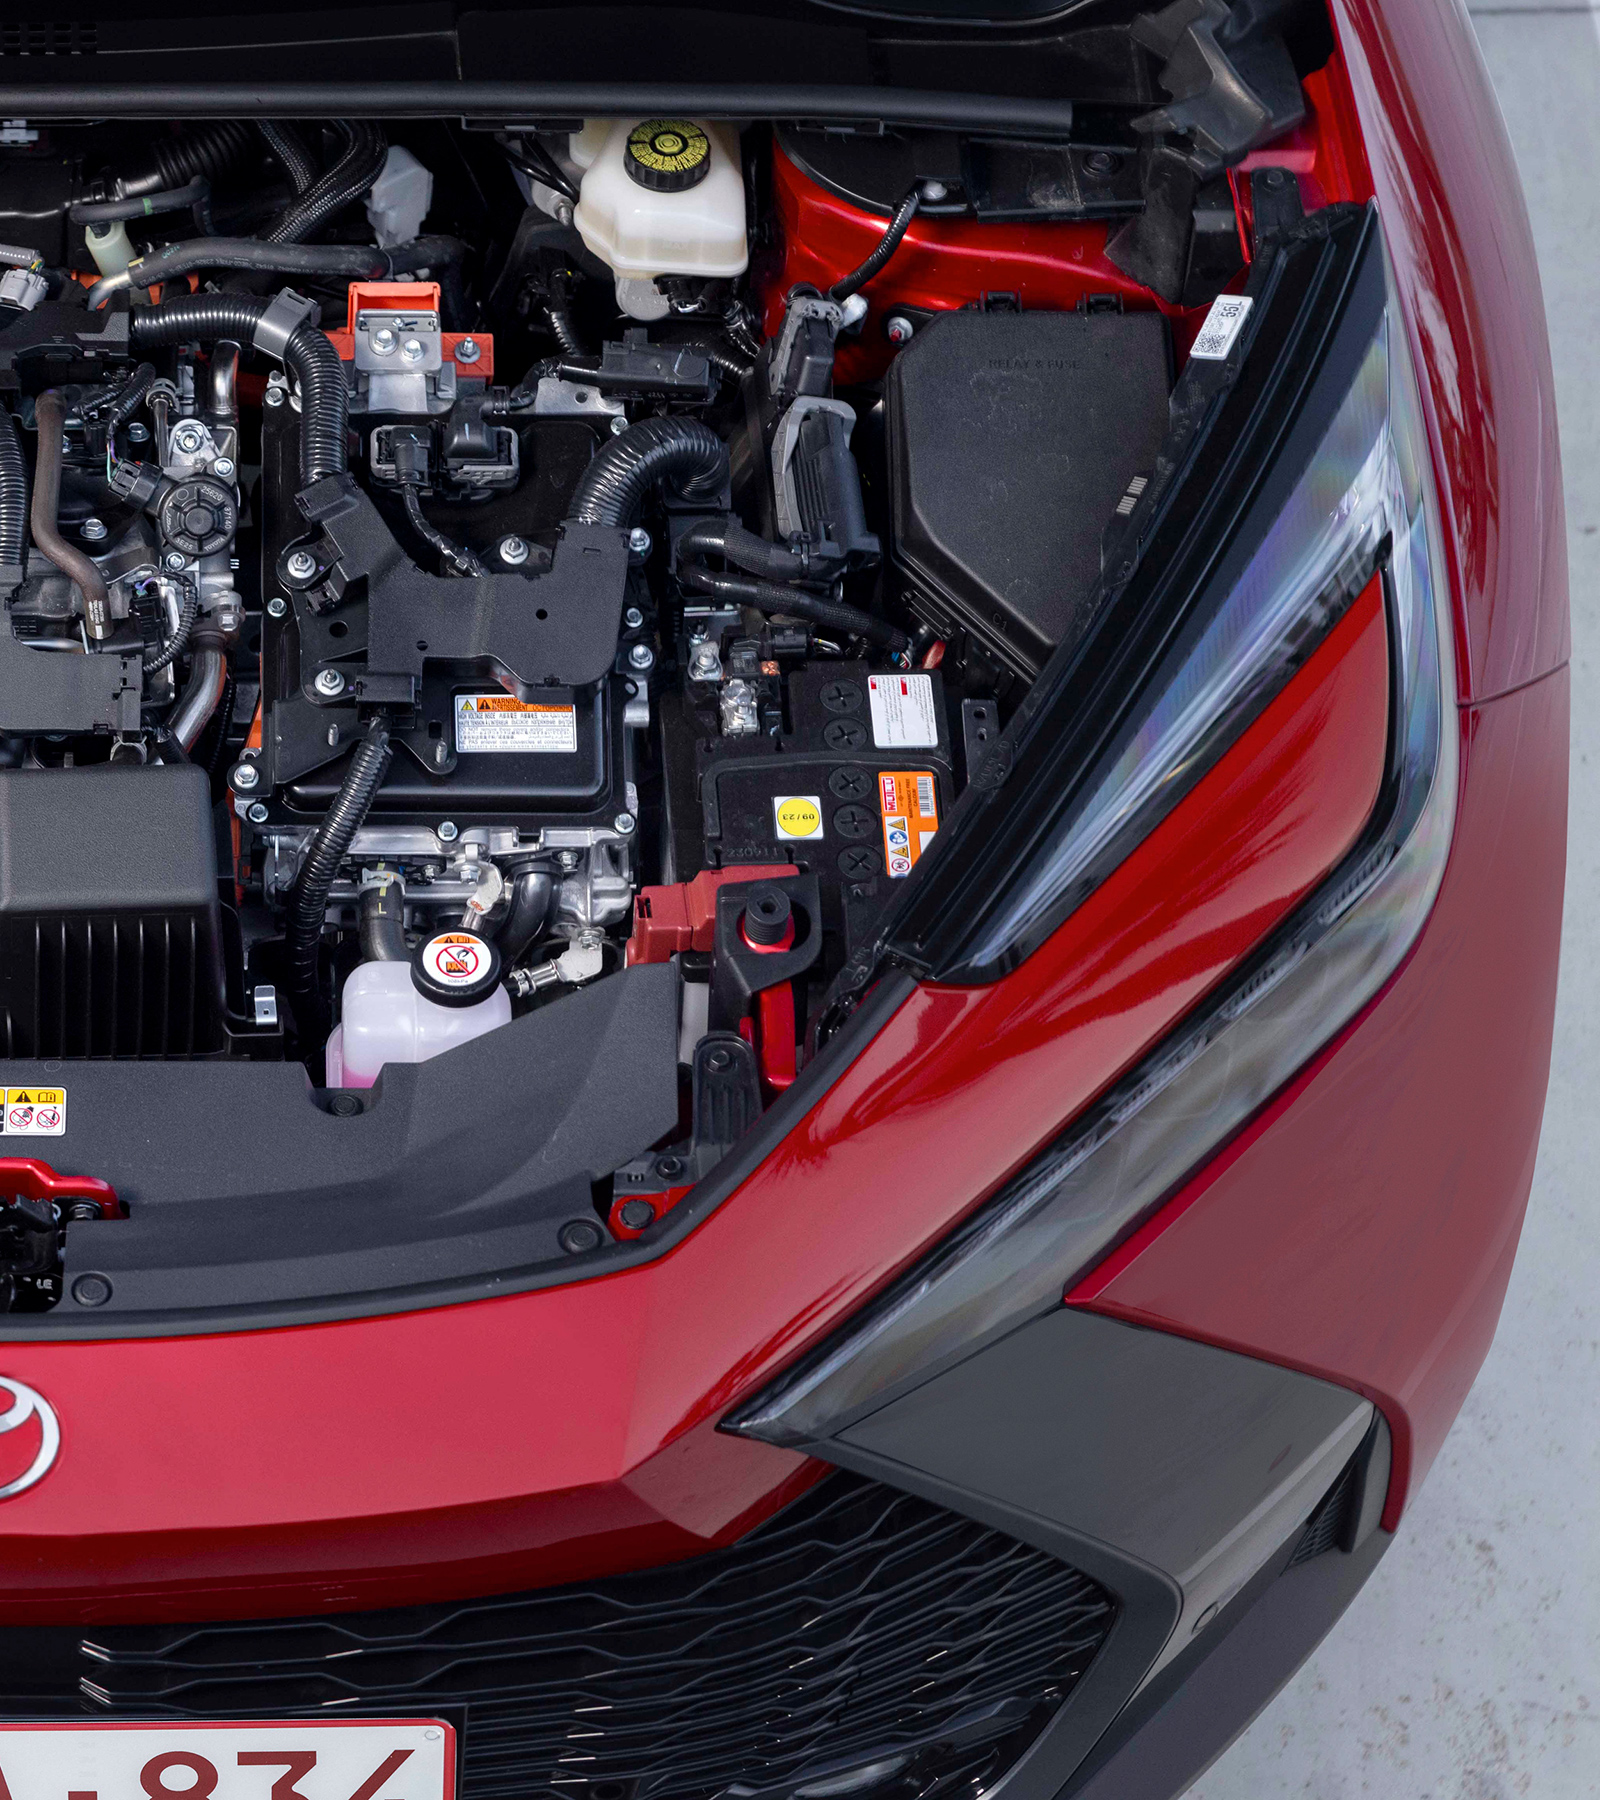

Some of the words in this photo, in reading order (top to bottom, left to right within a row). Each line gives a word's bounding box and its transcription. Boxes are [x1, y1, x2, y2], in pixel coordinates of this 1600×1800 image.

[1220, 301, 1242, 318] 55L
[988, 359, 1031, 370] RELAY
[1046, 359, 1081, 370] FUSE
[200, 485, 224, 501] 25620
[223, 506, 232, 530] 37140
[204, 537, 226, 552] TOYOTA
